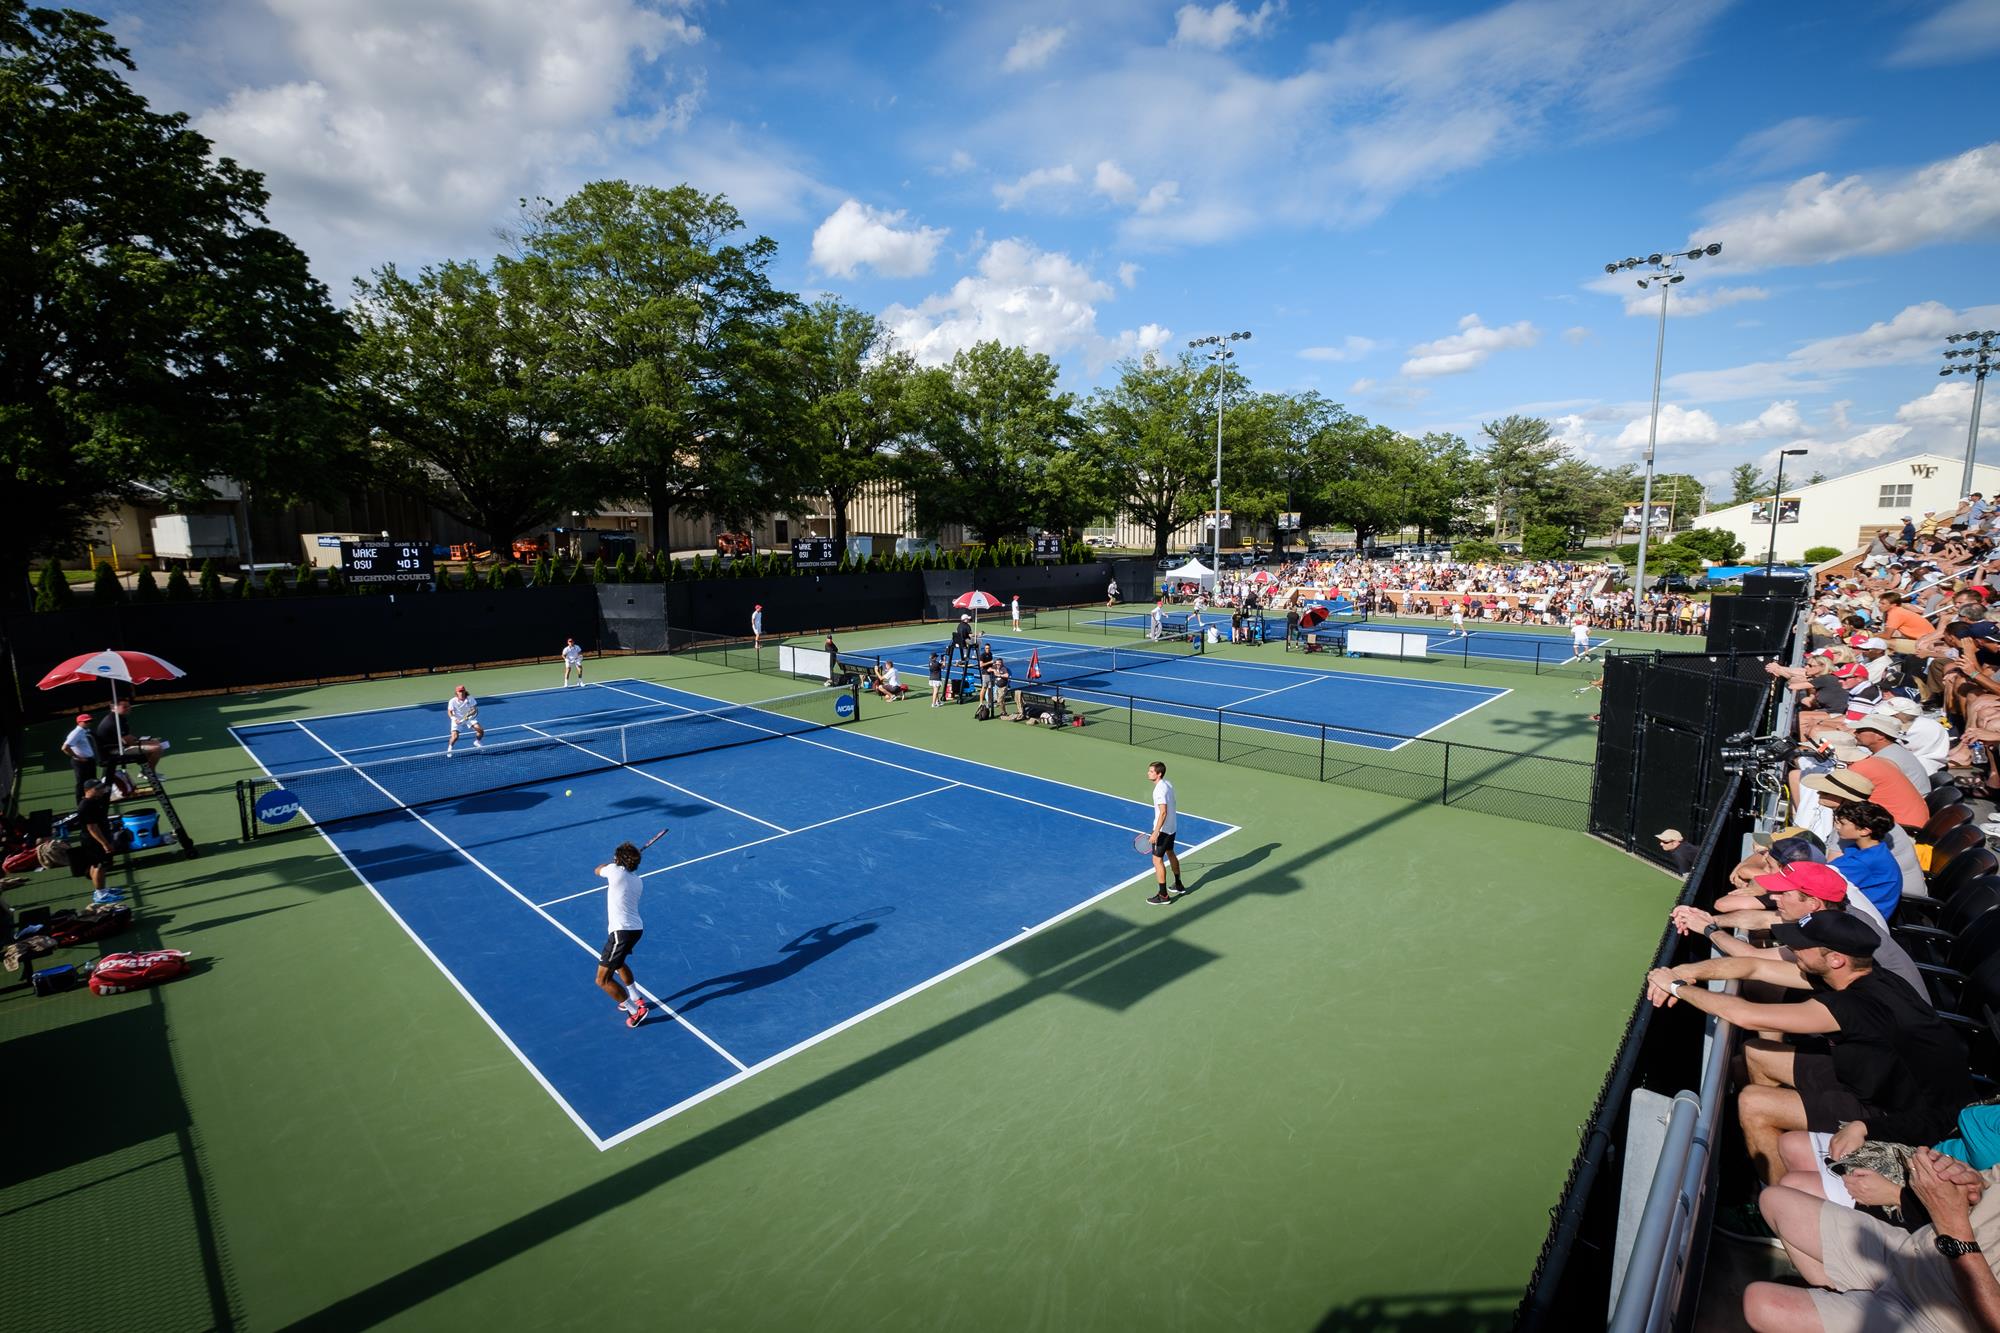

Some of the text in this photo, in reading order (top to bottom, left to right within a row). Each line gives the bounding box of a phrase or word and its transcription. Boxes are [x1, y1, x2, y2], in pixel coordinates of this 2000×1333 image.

[1910, 464, 1938, 479] WF
[798, 543, 812, 551] WAKE
[352, 548, 378, 558] WAKE
[353, 560, 373, 570] OSU
[397, 559, 411, 569] 40
[349, 573, 431, 583] LEIGHTON COURTS
[389, 594, 395, 603] 1
[837, 704, 855, 713] NCAA
[261, 802, 299, 820] NCAA
